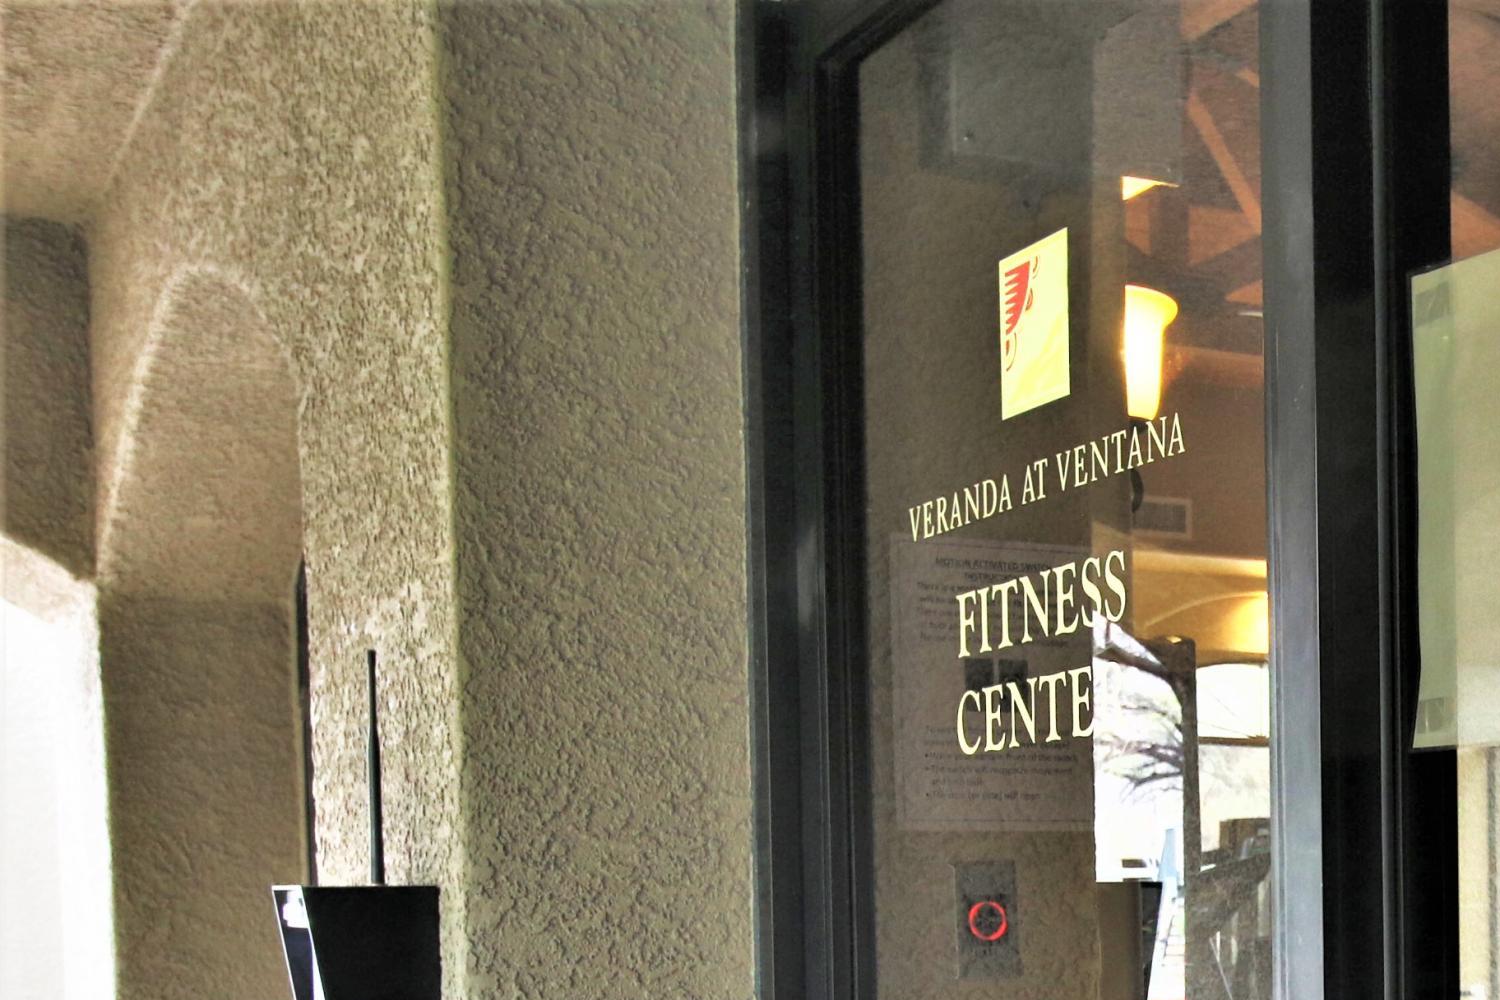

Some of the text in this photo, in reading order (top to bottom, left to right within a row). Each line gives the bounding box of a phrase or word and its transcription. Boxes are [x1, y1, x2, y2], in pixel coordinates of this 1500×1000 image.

[909, 412, 1186, 542] VERANDA AT VENTANA
[956, 550, 1126, 659] FITNESS
[956, 665, 1094, 755] CENTE
